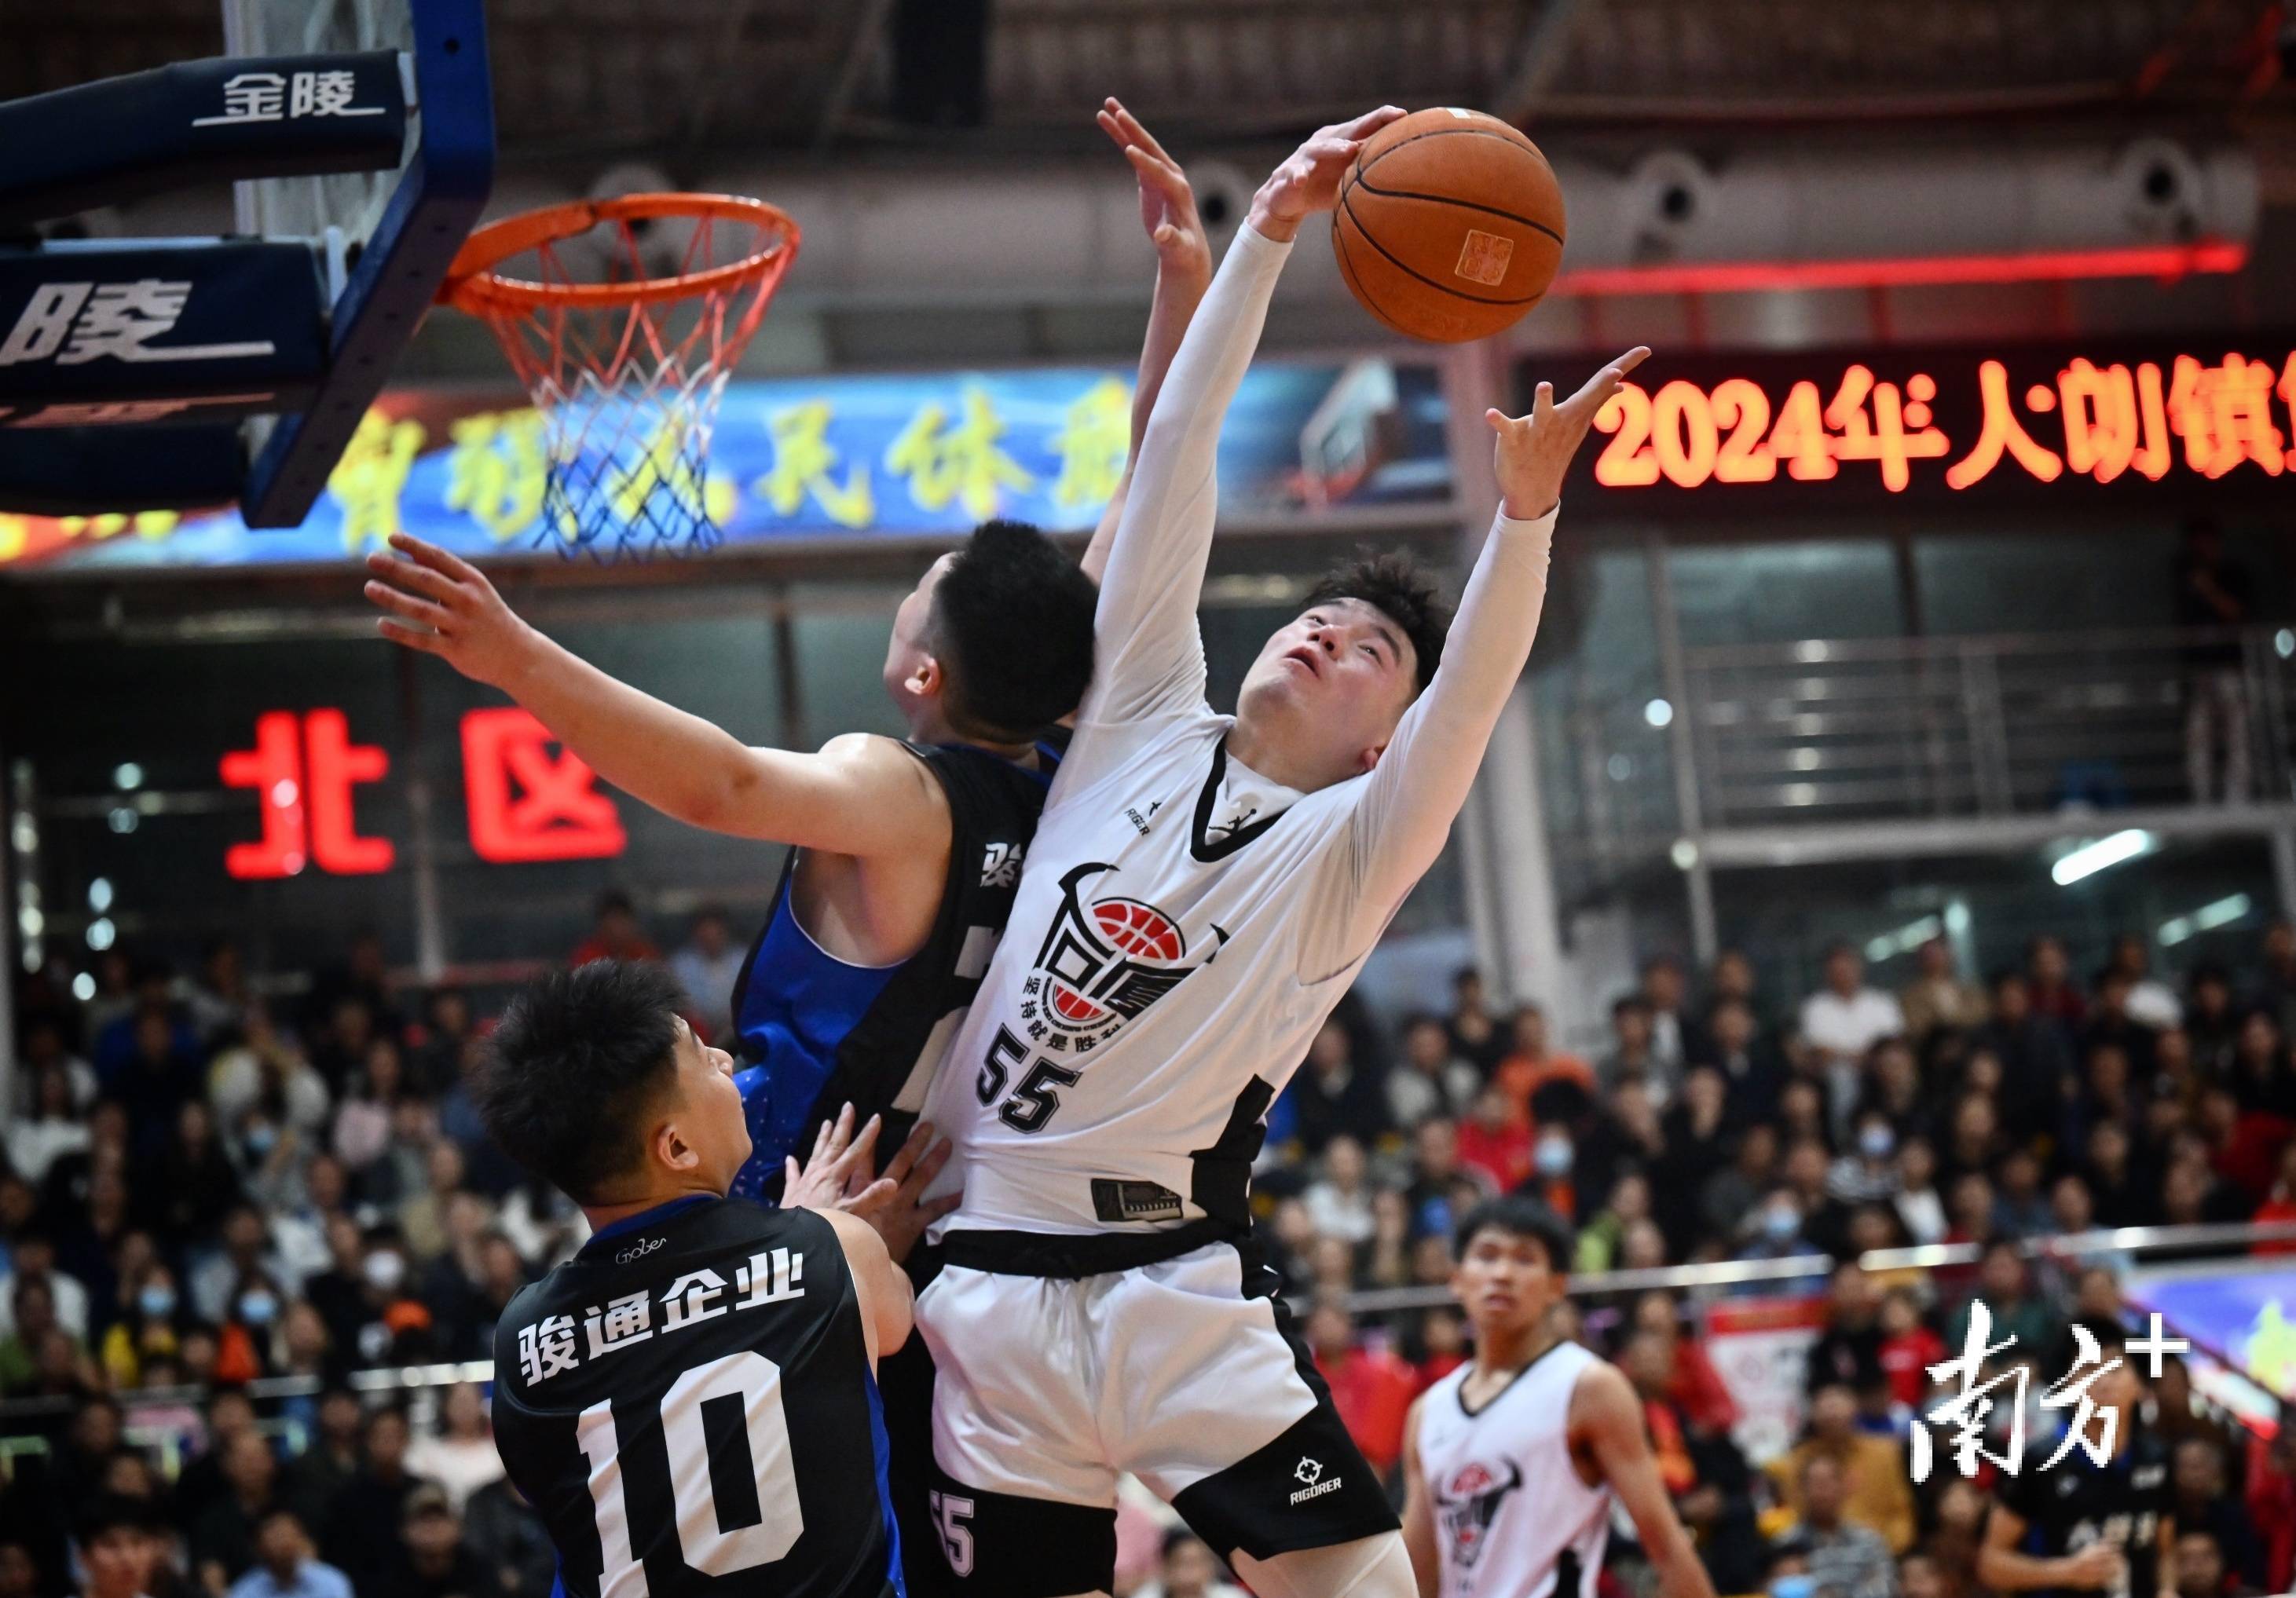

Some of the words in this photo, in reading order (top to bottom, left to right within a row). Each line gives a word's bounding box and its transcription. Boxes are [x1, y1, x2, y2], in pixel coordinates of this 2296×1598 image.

[192, 71, 386, 127] 金陵
[219, 707, 626, 880] 北区
[976, 1022, 1083, 1134] 55
[518, 1247, 805, 1387] 骏通企业
[576, 1350, 804, 1598] 10
[1290, 1477, 1342, 1506] RIGORER
